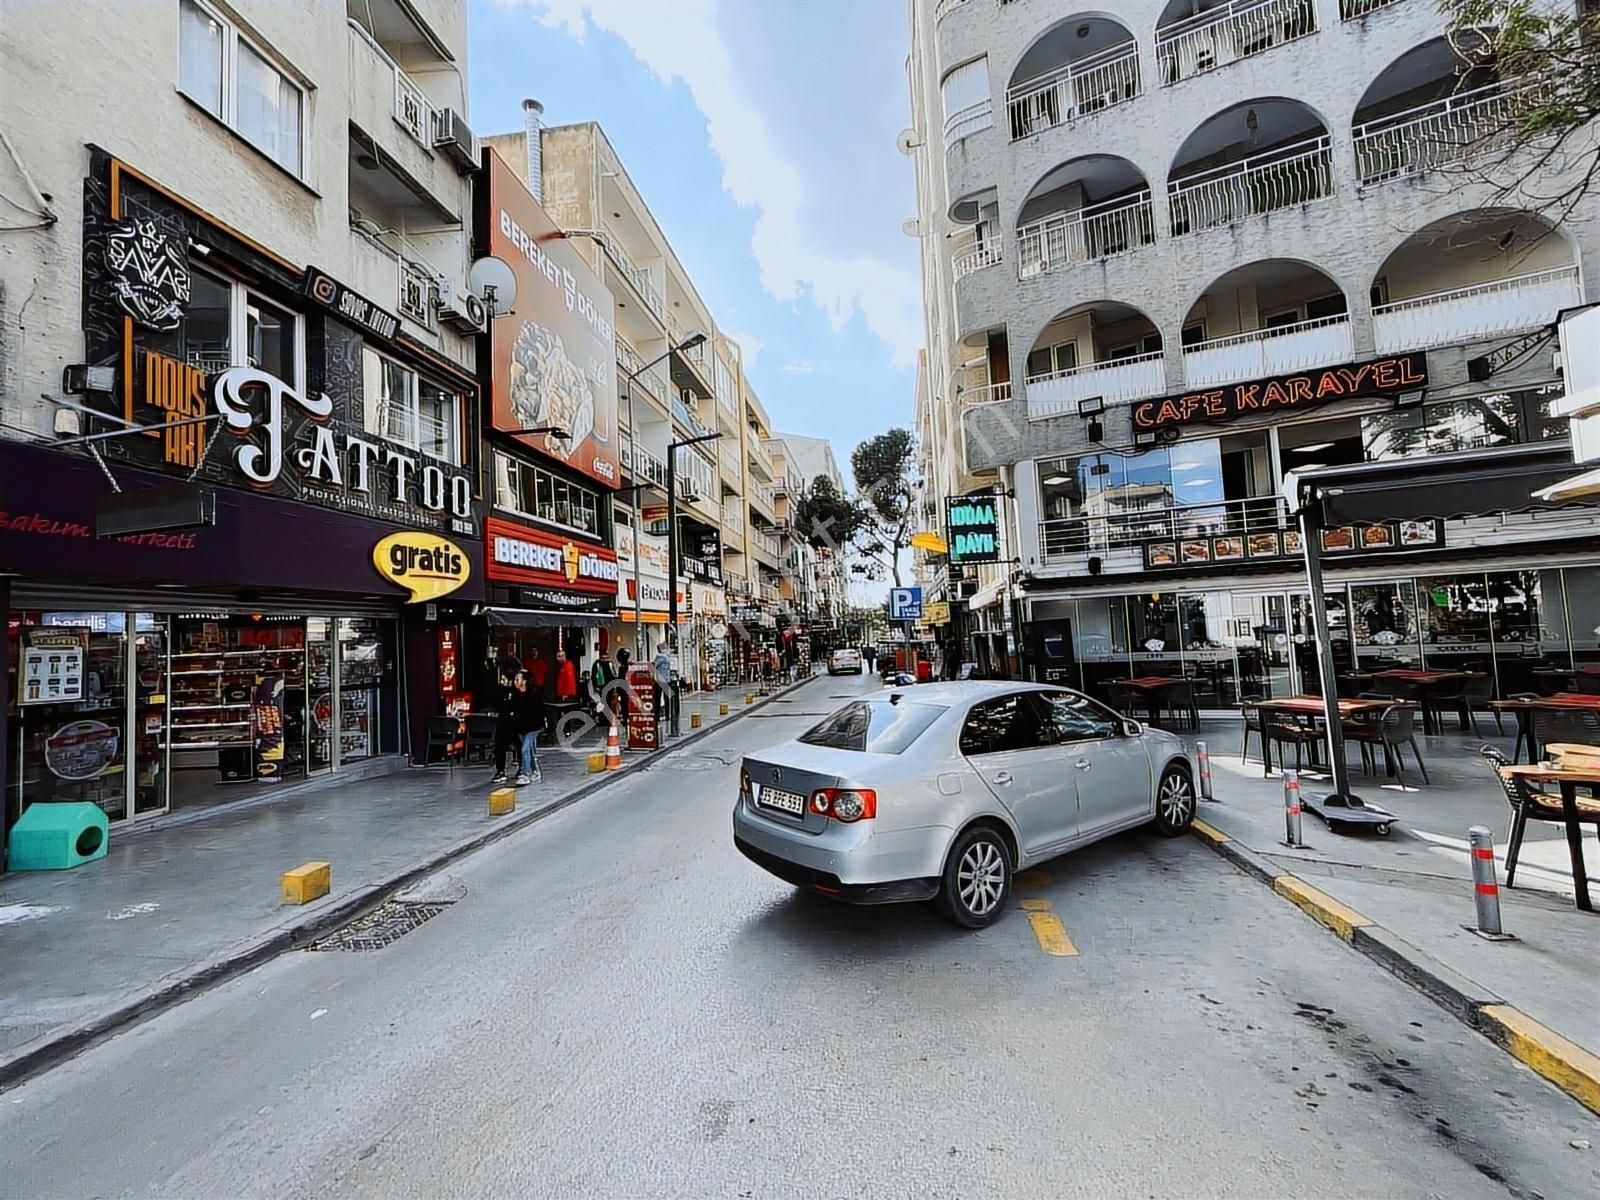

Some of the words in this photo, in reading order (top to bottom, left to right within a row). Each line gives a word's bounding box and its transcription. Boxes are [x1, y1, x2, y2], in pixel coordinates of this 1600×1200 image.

[500, 206, 562, 289] BEREKET
[577, 292, 612, 344] DÖNER
[1134, 389, 1227, 428] CAFE
[1236, 357, 1426, 411] KARAYEL
[214, 365, 472, 518] TATTOO
[302, 486, 375, 512] PROFESSIONAL
[389, 543, 462, 576] gratis
[494, 535, 563, 572] BEREKET
[578, 552, 619, 580] DÖNER
